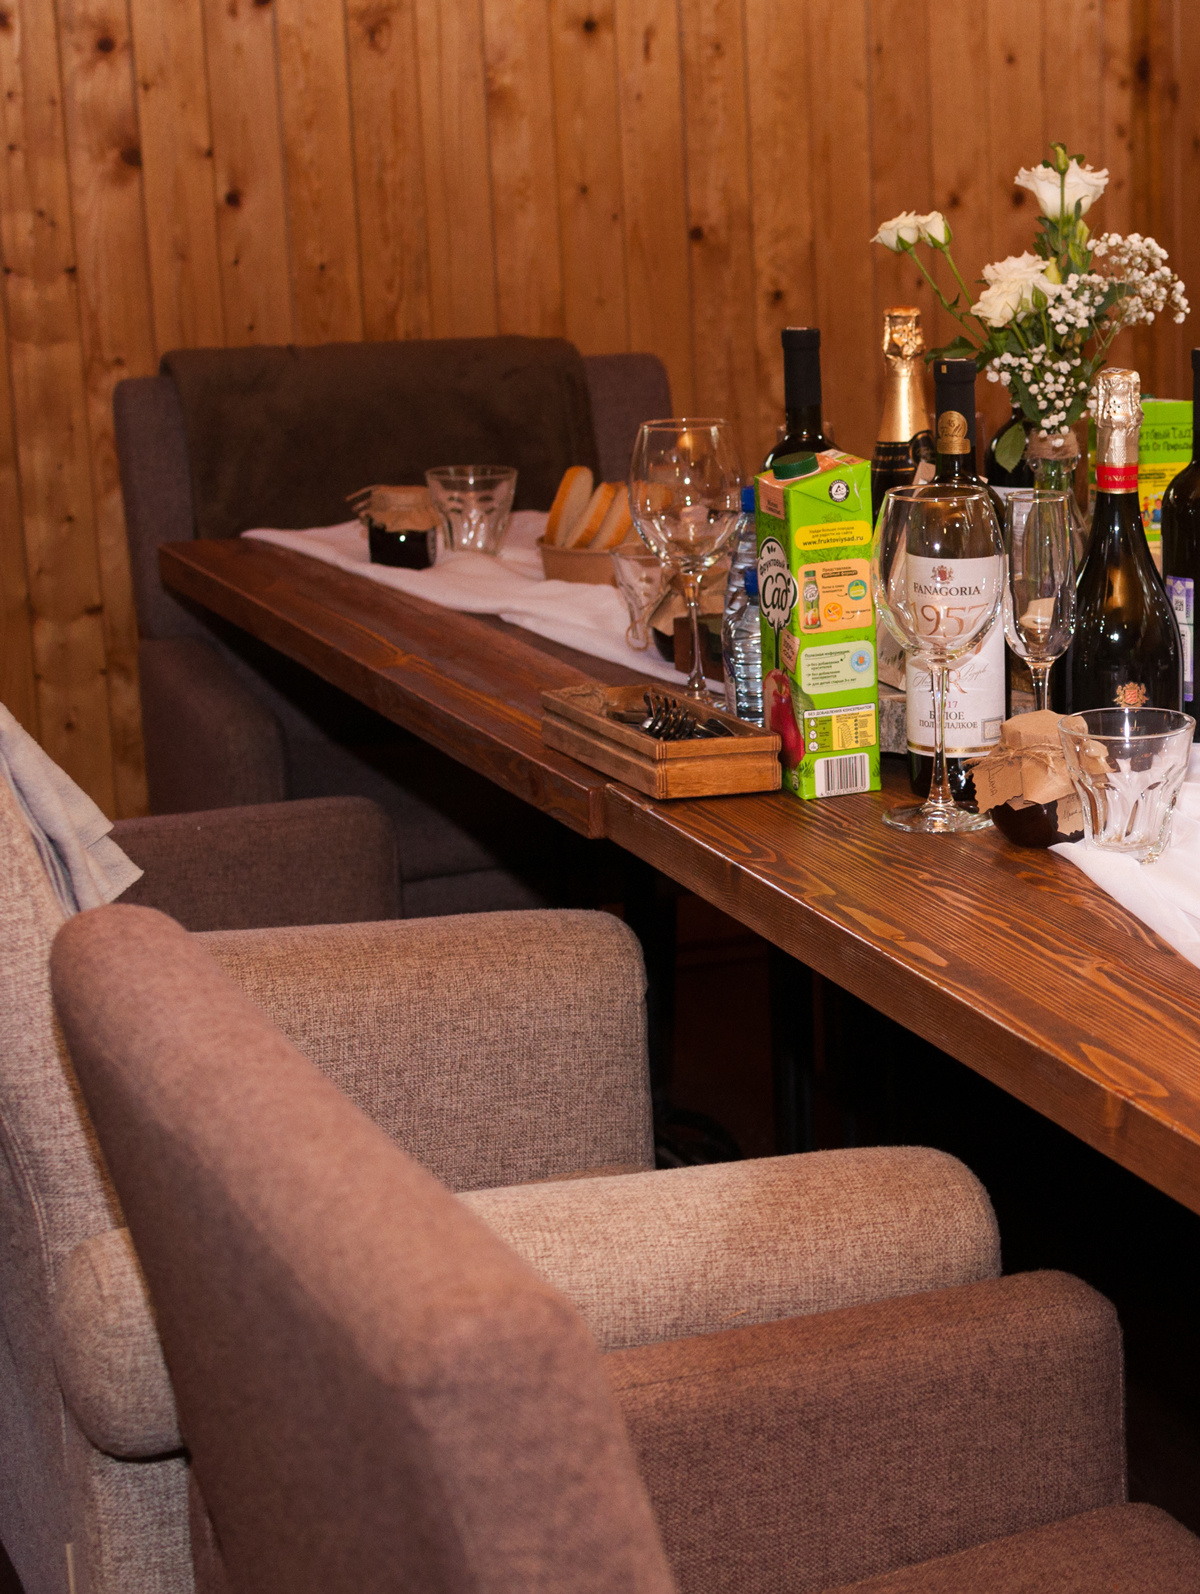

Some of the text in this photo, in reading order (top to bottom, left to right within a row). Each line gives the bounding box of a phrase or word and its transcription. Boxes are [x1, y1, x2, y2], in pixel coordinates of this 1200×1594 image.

[802, 536, 864, 546] www.fruktoviysad.ru
[762, 573, 788, 612] Сад
[913, 582, 981, 596] FANAGORIA
[910, 602, 989, 637] 1957
[929, 710, 965, 721] БЛОЕ
[919, 720, 978, 731] ПОЛЛАДКОЕ
